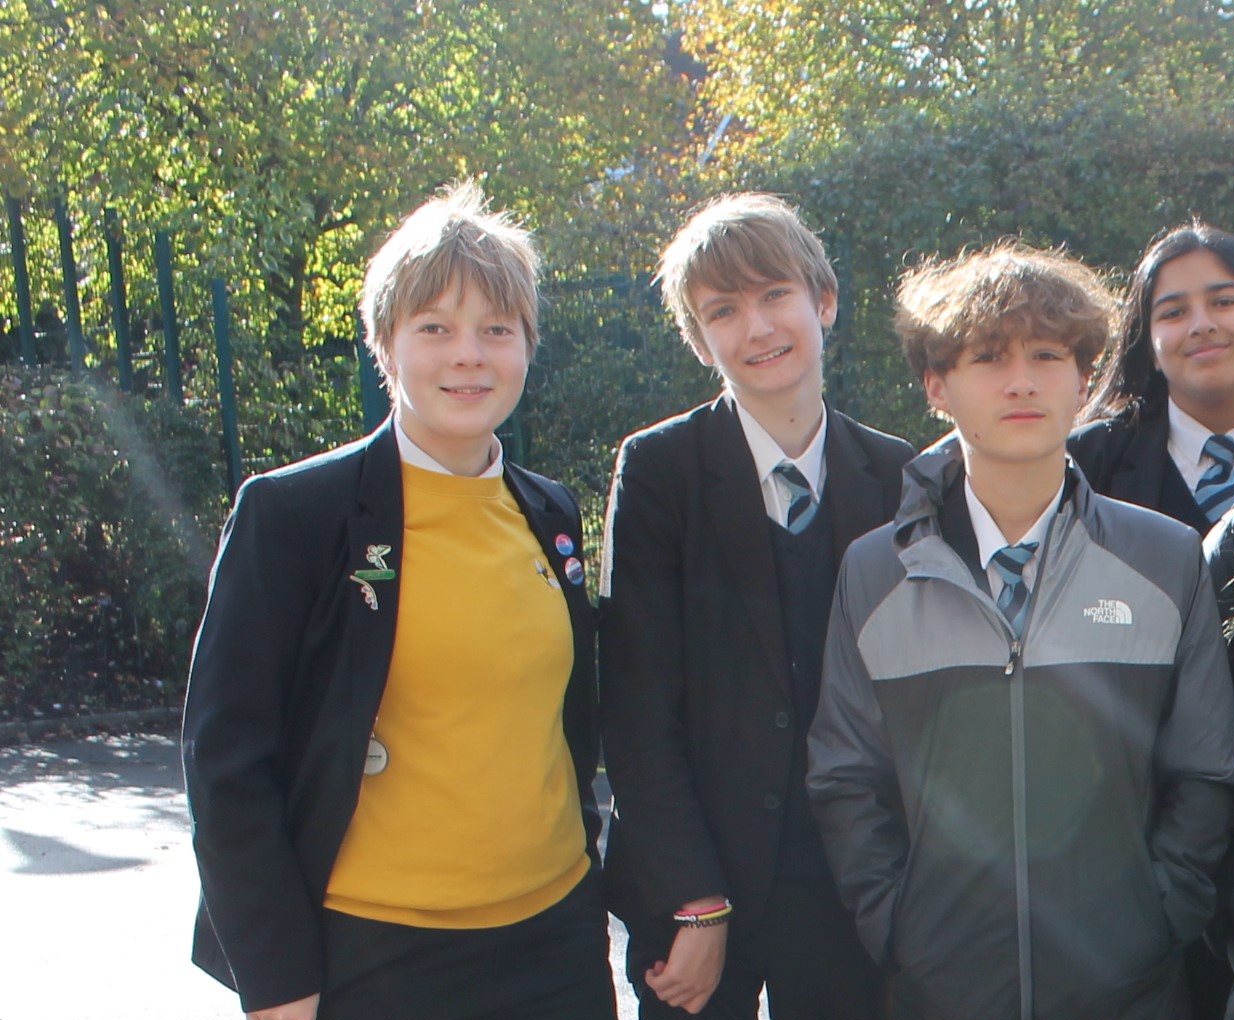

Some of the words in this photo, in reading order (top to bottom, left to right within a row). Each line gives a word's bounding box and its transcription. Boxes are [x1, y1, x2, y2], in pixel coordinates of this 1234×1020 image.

[1098, 600, 1116, 608] THE
[1083, 608, 1116, 617] NORTH
[1092, 615, 1116, 624] FACE
